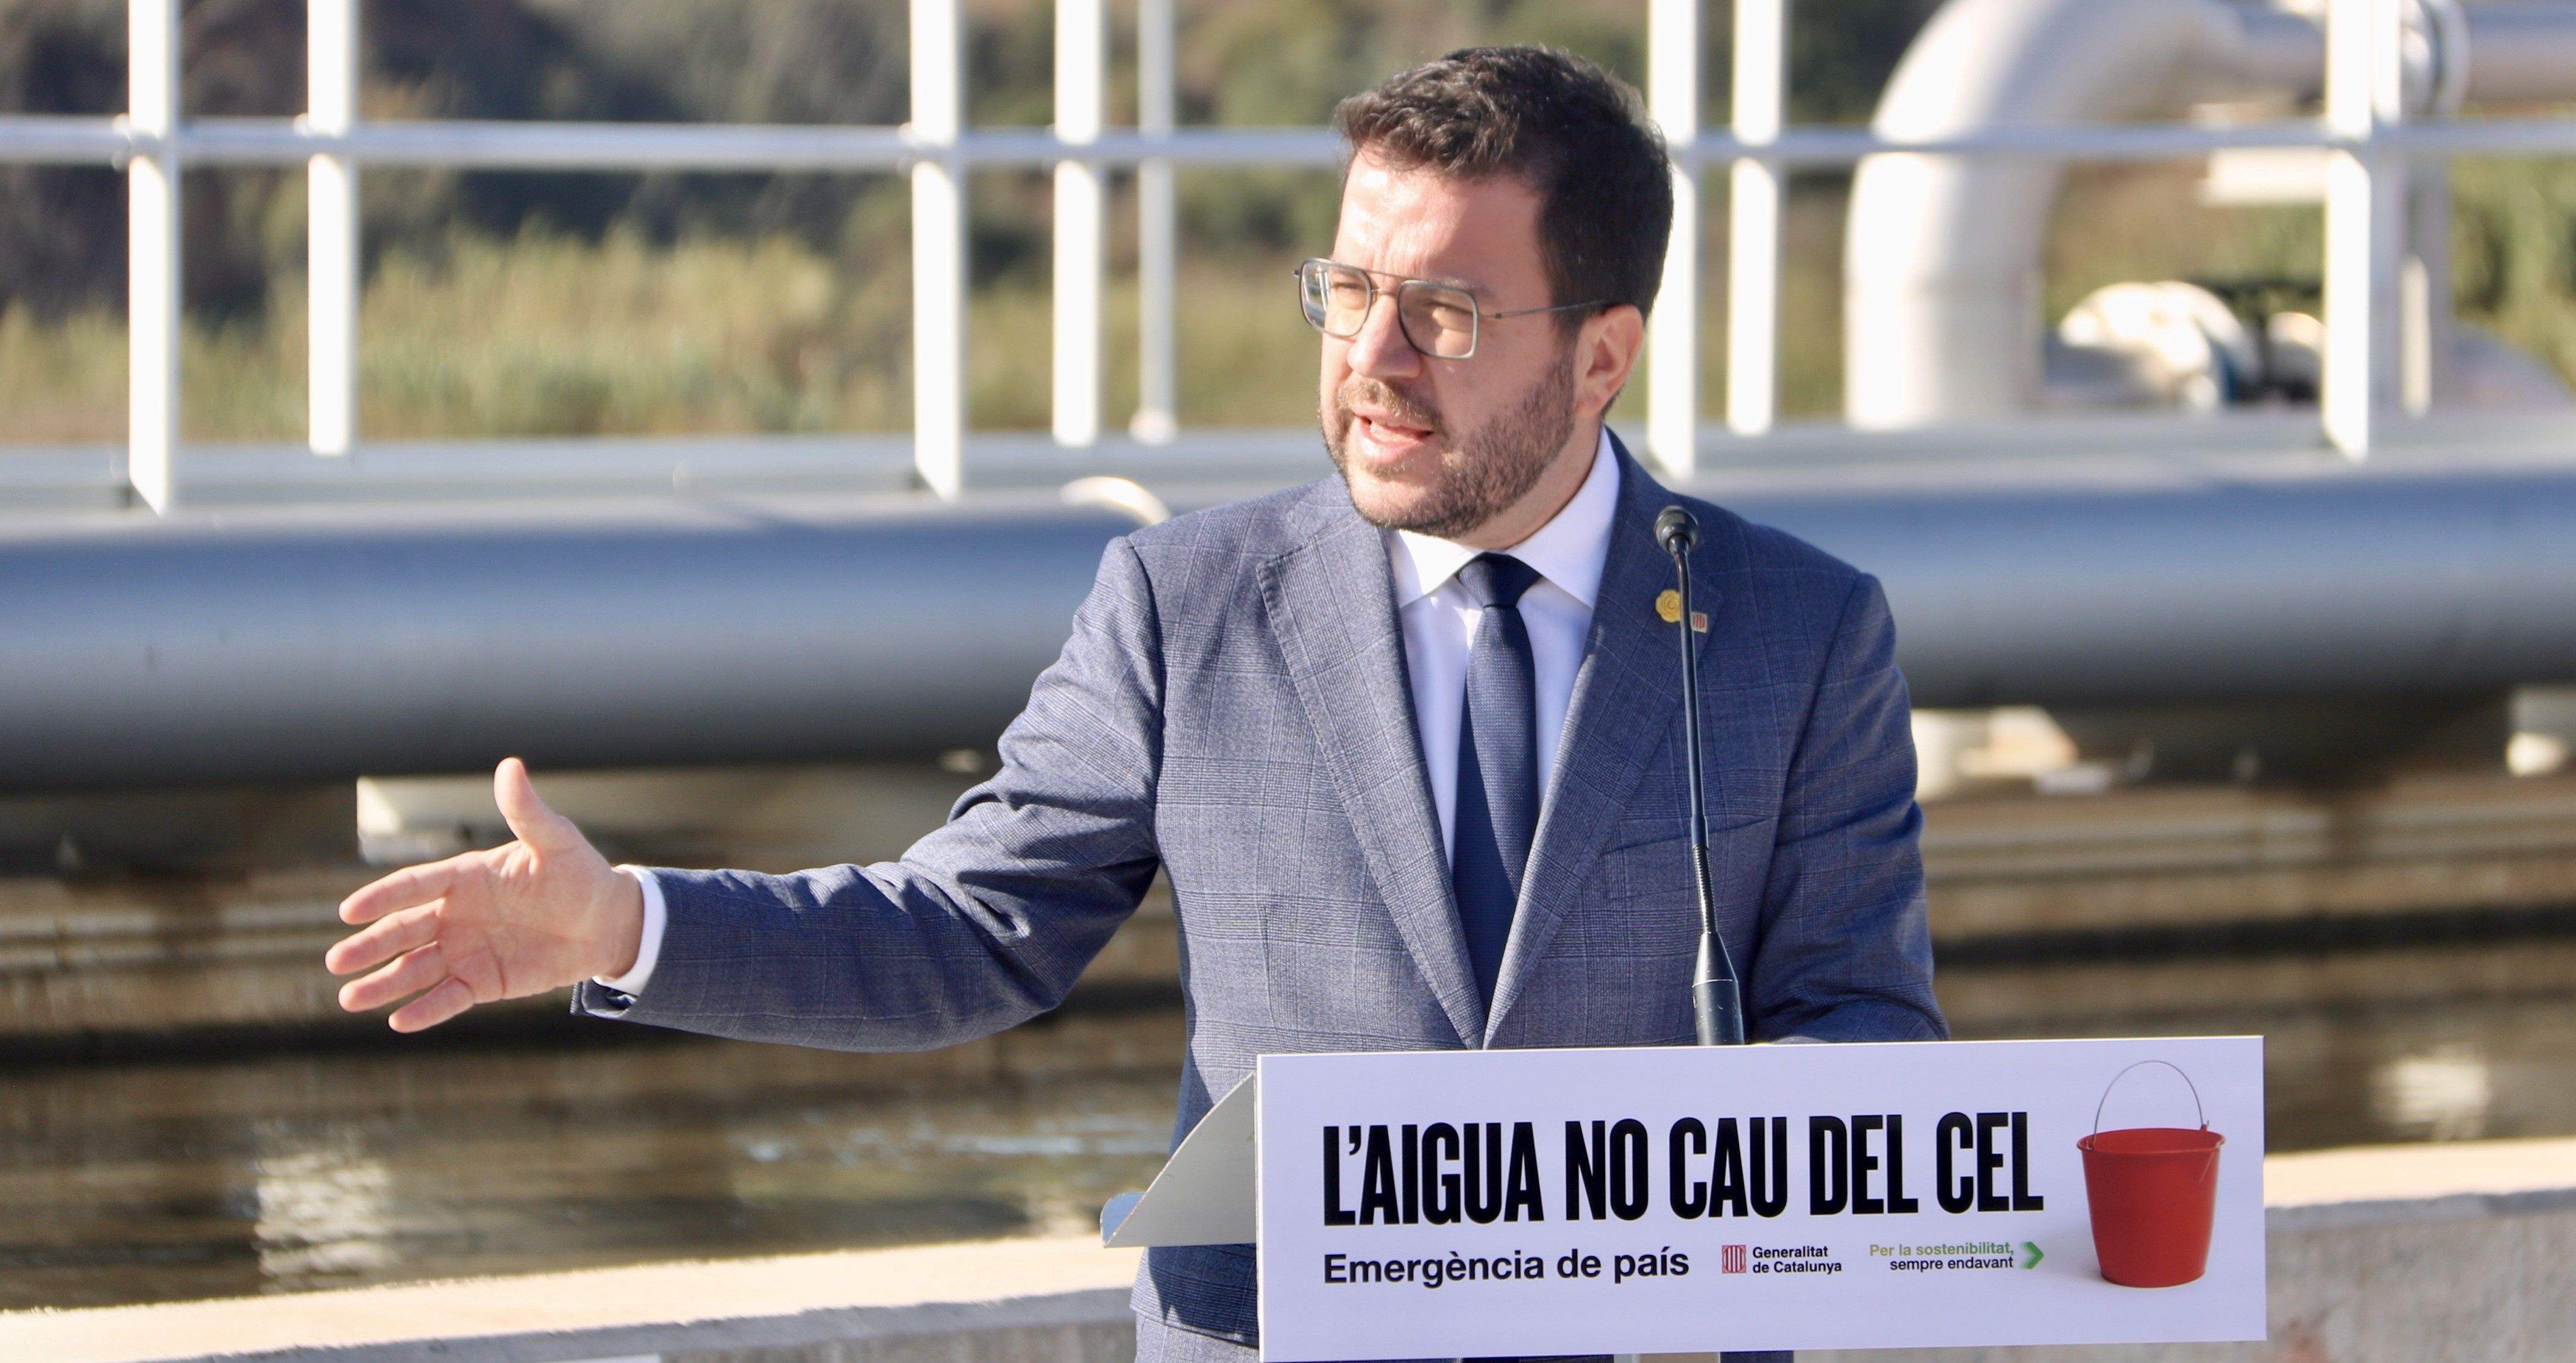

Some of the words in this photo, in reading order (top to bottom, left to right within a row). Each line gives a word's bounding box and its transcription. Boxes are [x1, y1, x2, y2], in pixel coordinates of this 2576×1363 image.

[1324, 1122, 1544, 1226] L’AIGUA
[1565, 1118, 1649, 1221] NO
[1669, 1116, 1787, 1220] CAU
[1810, 1115, 1918, 1215] DEL
[1936, 1112, 2044, 1214] CEL
[1752, 1245, 1828, 1258] Generalitat
[1869, 1244, 1895, 1256] Per
[1899, 1244, 1911, 1256] la
[1916, 1242, 2014, 1256] sostenibilitat,
[1324, 1250, 1544, 1288] Emergència
[1557, 1248, 1602, 1279] de
[1615, 1246, 1690, 1284] país
[1752, 1262, 1769, 1273] de
[1773, 1261, 1842, 1274] Catalunya
[1890, 1260, 1943, 1272] sempre
[1948, 1256, 2014, 1270] endavant
